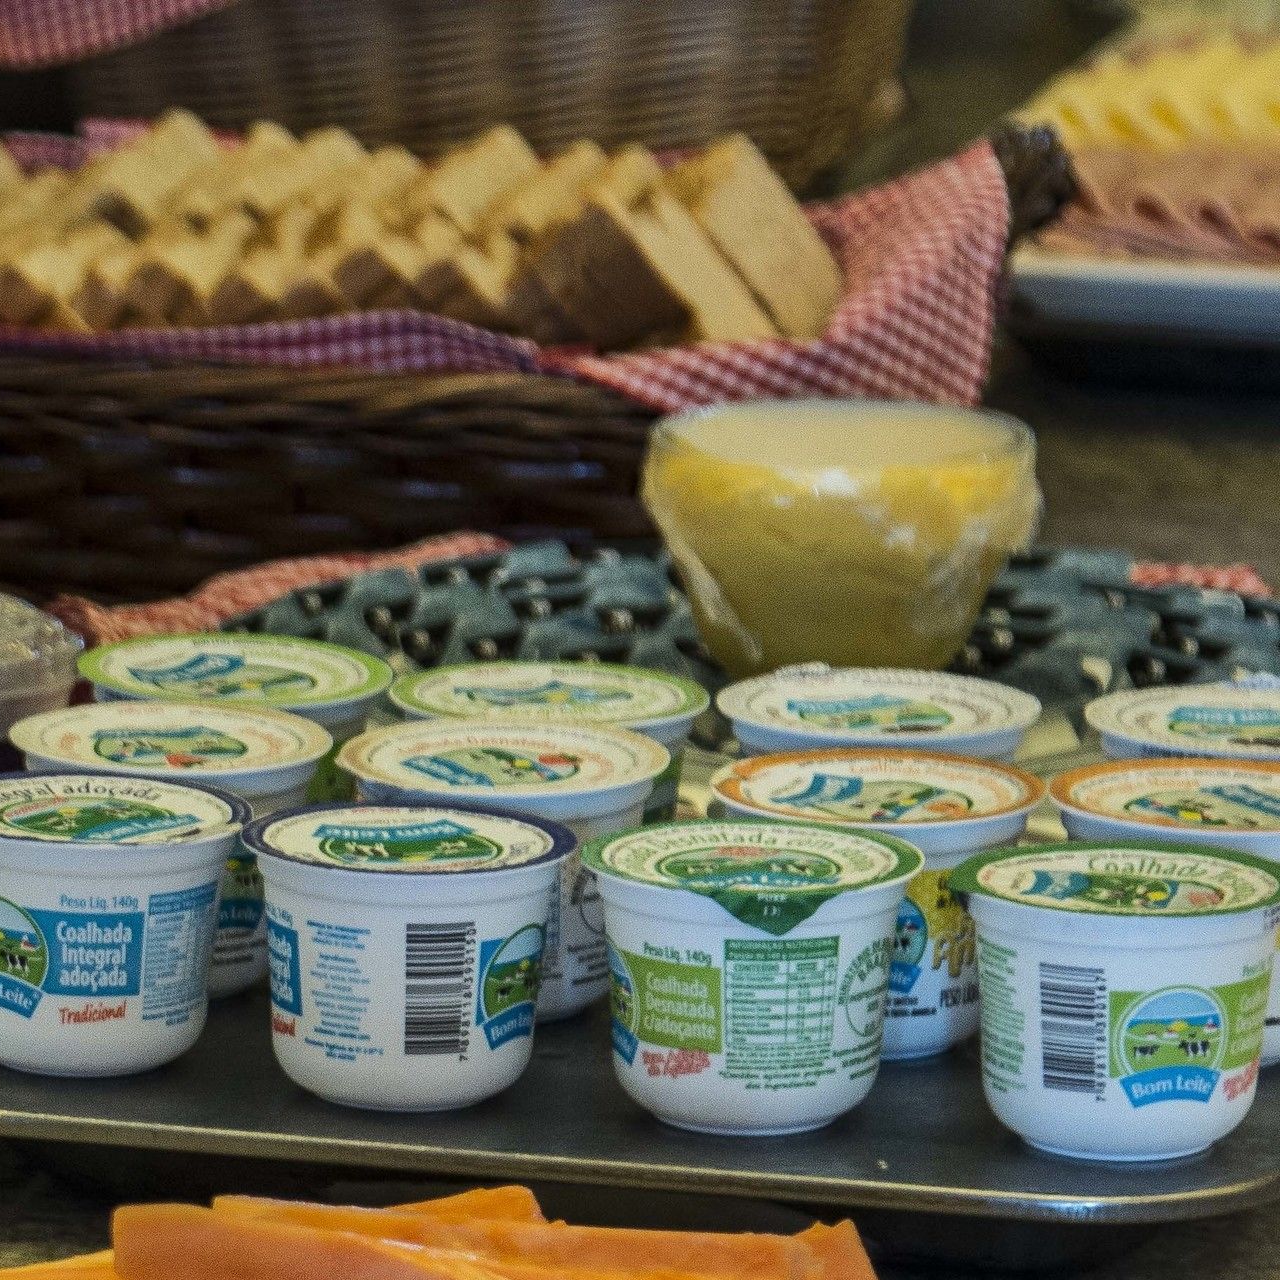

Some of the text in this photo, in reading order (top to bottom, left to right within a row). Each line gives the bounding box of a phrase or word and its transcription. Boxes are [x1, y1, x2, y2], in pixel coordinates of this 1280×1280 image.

[63, 781, 161, 801] adoçada
[1088, 856, 1209, 878] Coalhada
[60, 894, 86, 907] Peso
[112, 895, 139, 911] 140g
[56, 920, 132, 943] Coalhada
[61, 944, 127, 970] Integral
[685, 949, 713, 967] 140g
[59, 965, 128, 993] adoçada
[645, 971, 709, 999] Coalhada
[58, 999, 128, 1025] Tradicional
[644, 991, 716, 1020] Desnatada
[1131, 1078, 1174, 1099] Bom
[1176, 1073, 1213, 1095] Leite
